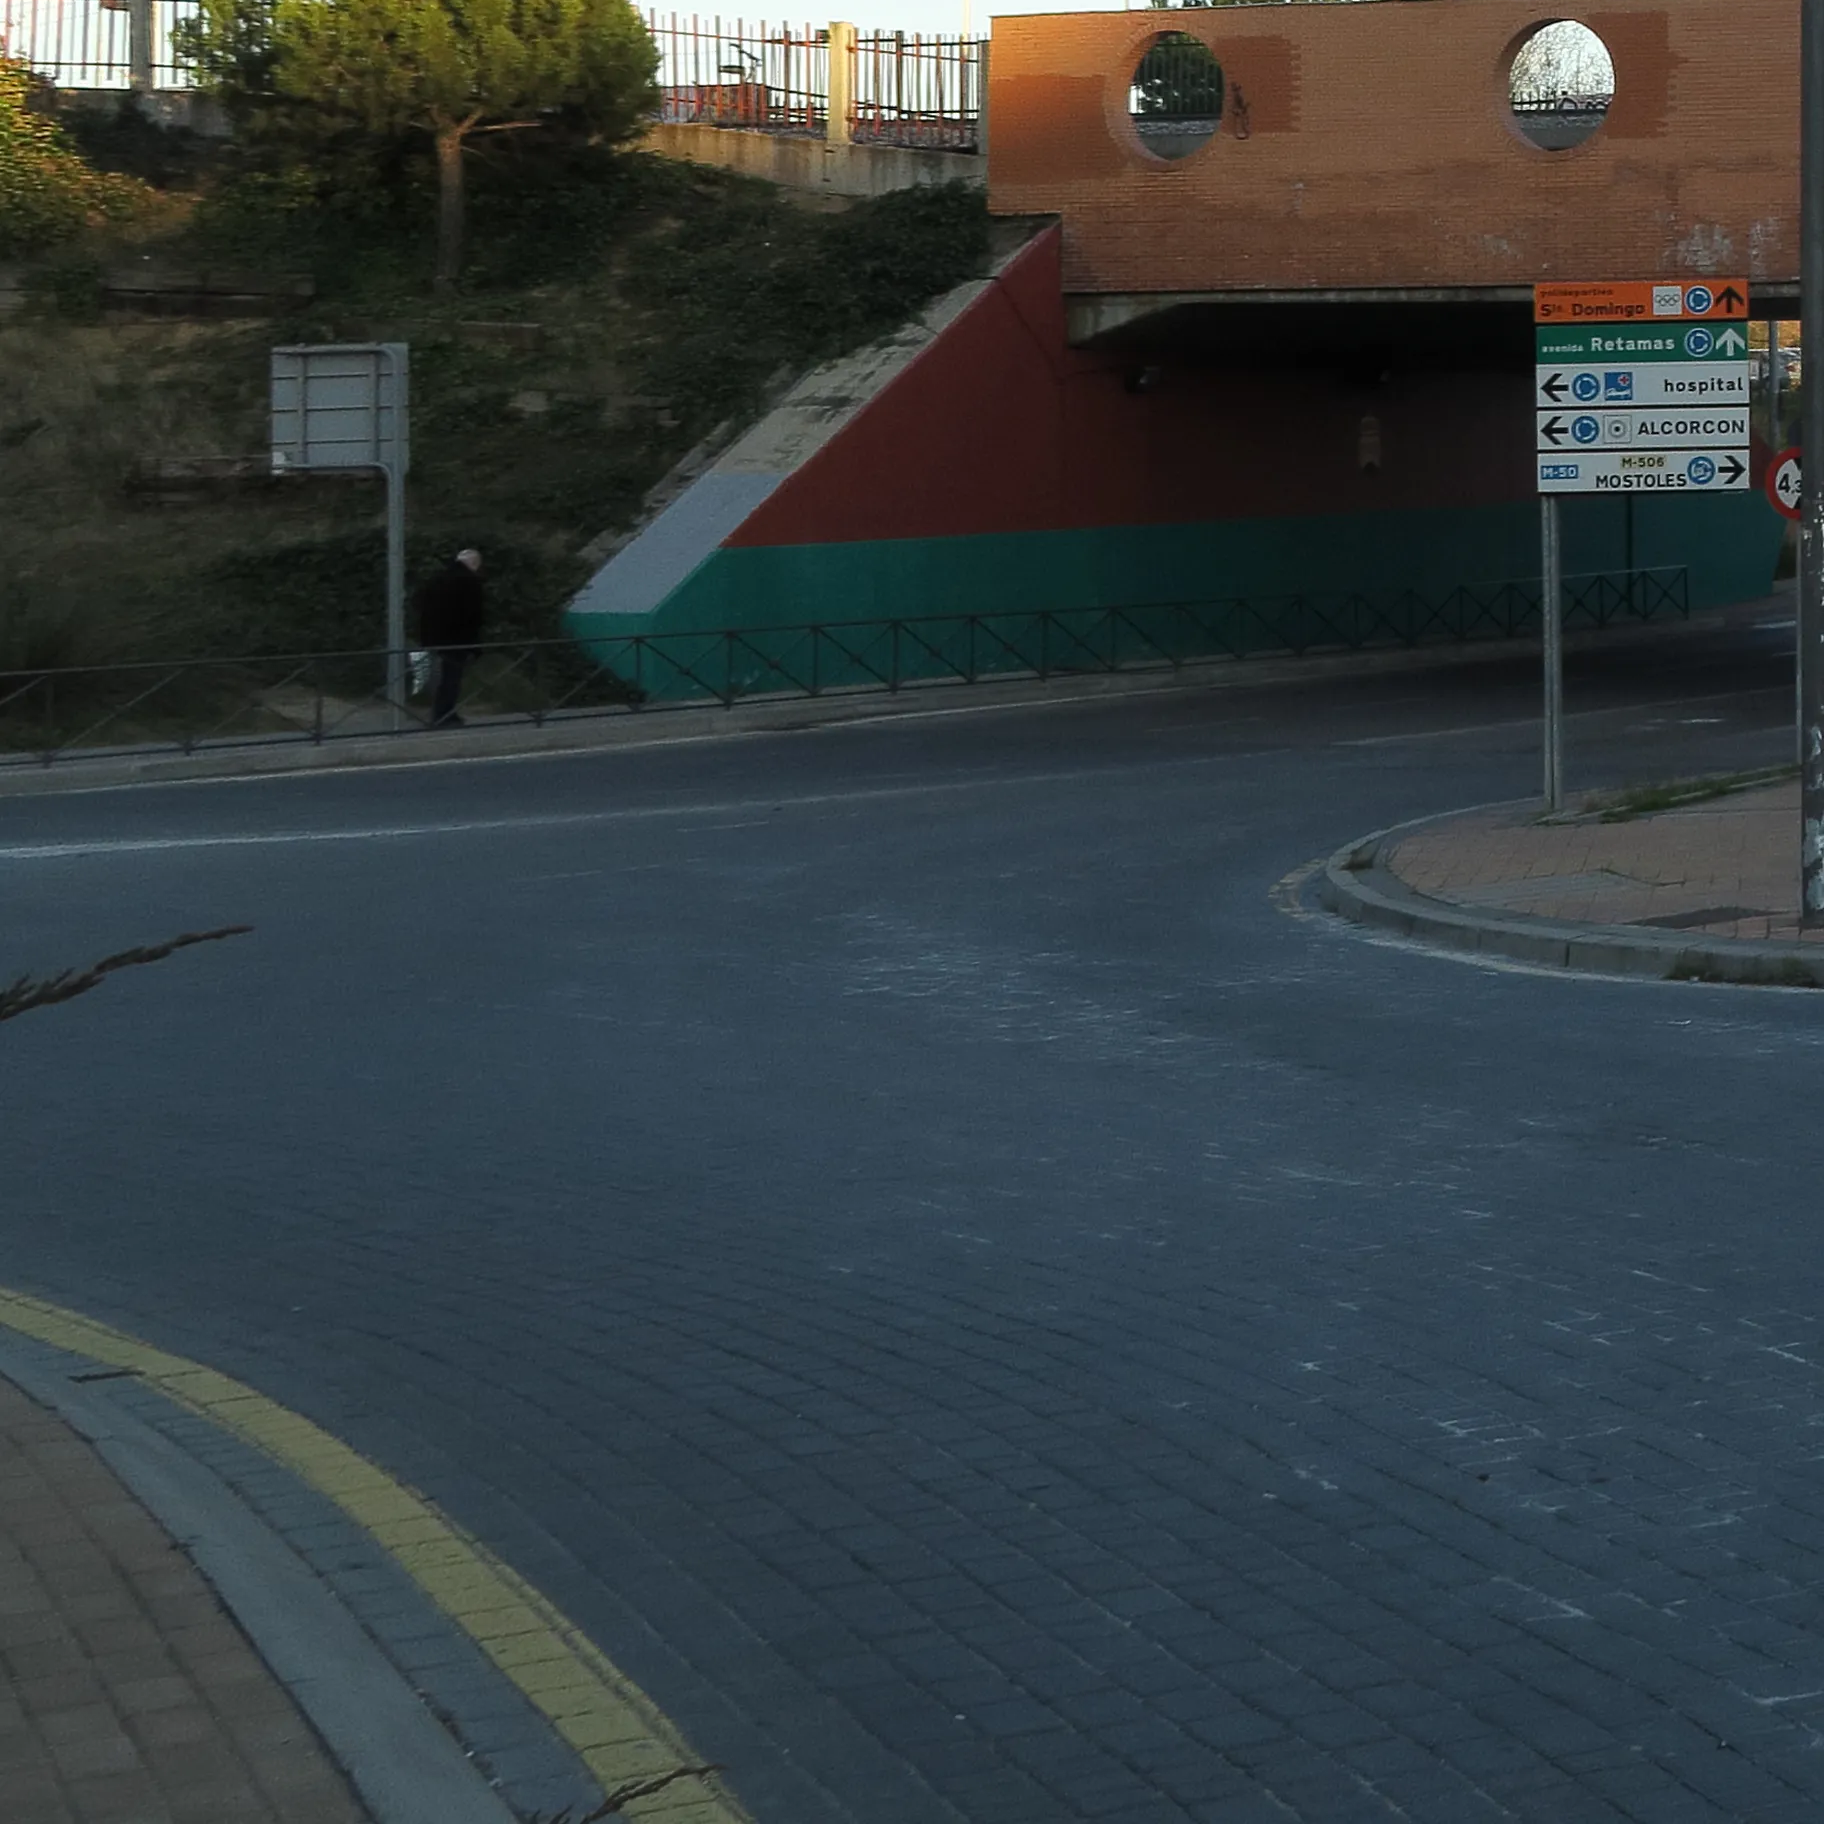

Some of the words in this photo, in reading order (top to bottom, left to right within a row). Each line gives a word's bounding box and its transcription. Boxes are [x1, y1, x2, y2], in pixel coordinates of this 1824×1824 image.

[1571, 302, 1646, 318] Domingo
[1541, 344, 1584, 353] avenida
[1590, 337, 1676, 352] Retamas
[1664, 377, 1744, 395] hospital
[1637, 419, 1745, 436] ALCORCON
[1621, 456, 1665, 469] M-506
[1542, 466, 1577, 479] M-50
[1595, 473, 1687, 489] MOSTOLES
